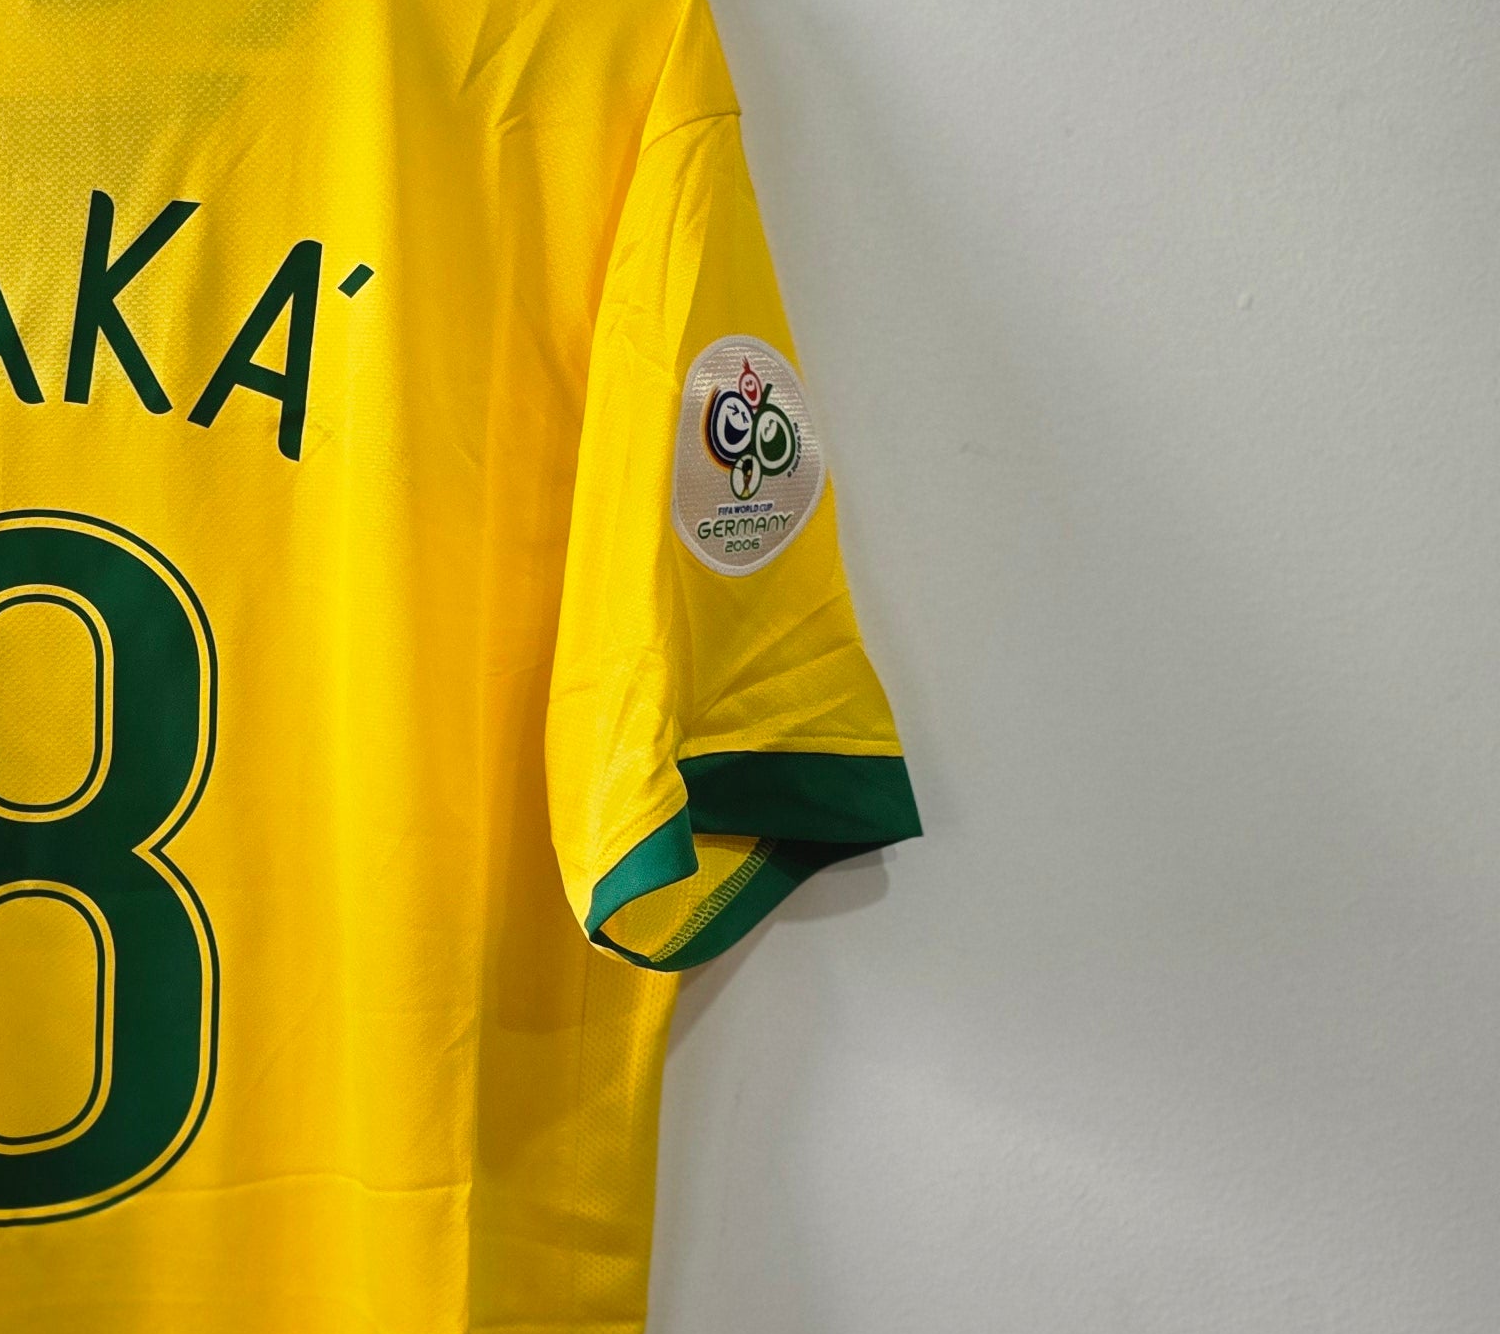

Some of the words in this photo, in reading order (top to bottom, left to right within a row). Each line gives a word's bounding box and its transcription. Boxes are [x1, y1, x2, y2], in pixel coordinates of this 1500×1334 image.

[717, 506, 733, 516] FIFA
[734, 504, 759, 514] WORLD
[759, 502, 774, 512] CUP
[697, 513, 794, 540] GERMANY
[724, 537, 761, 553] 2006
